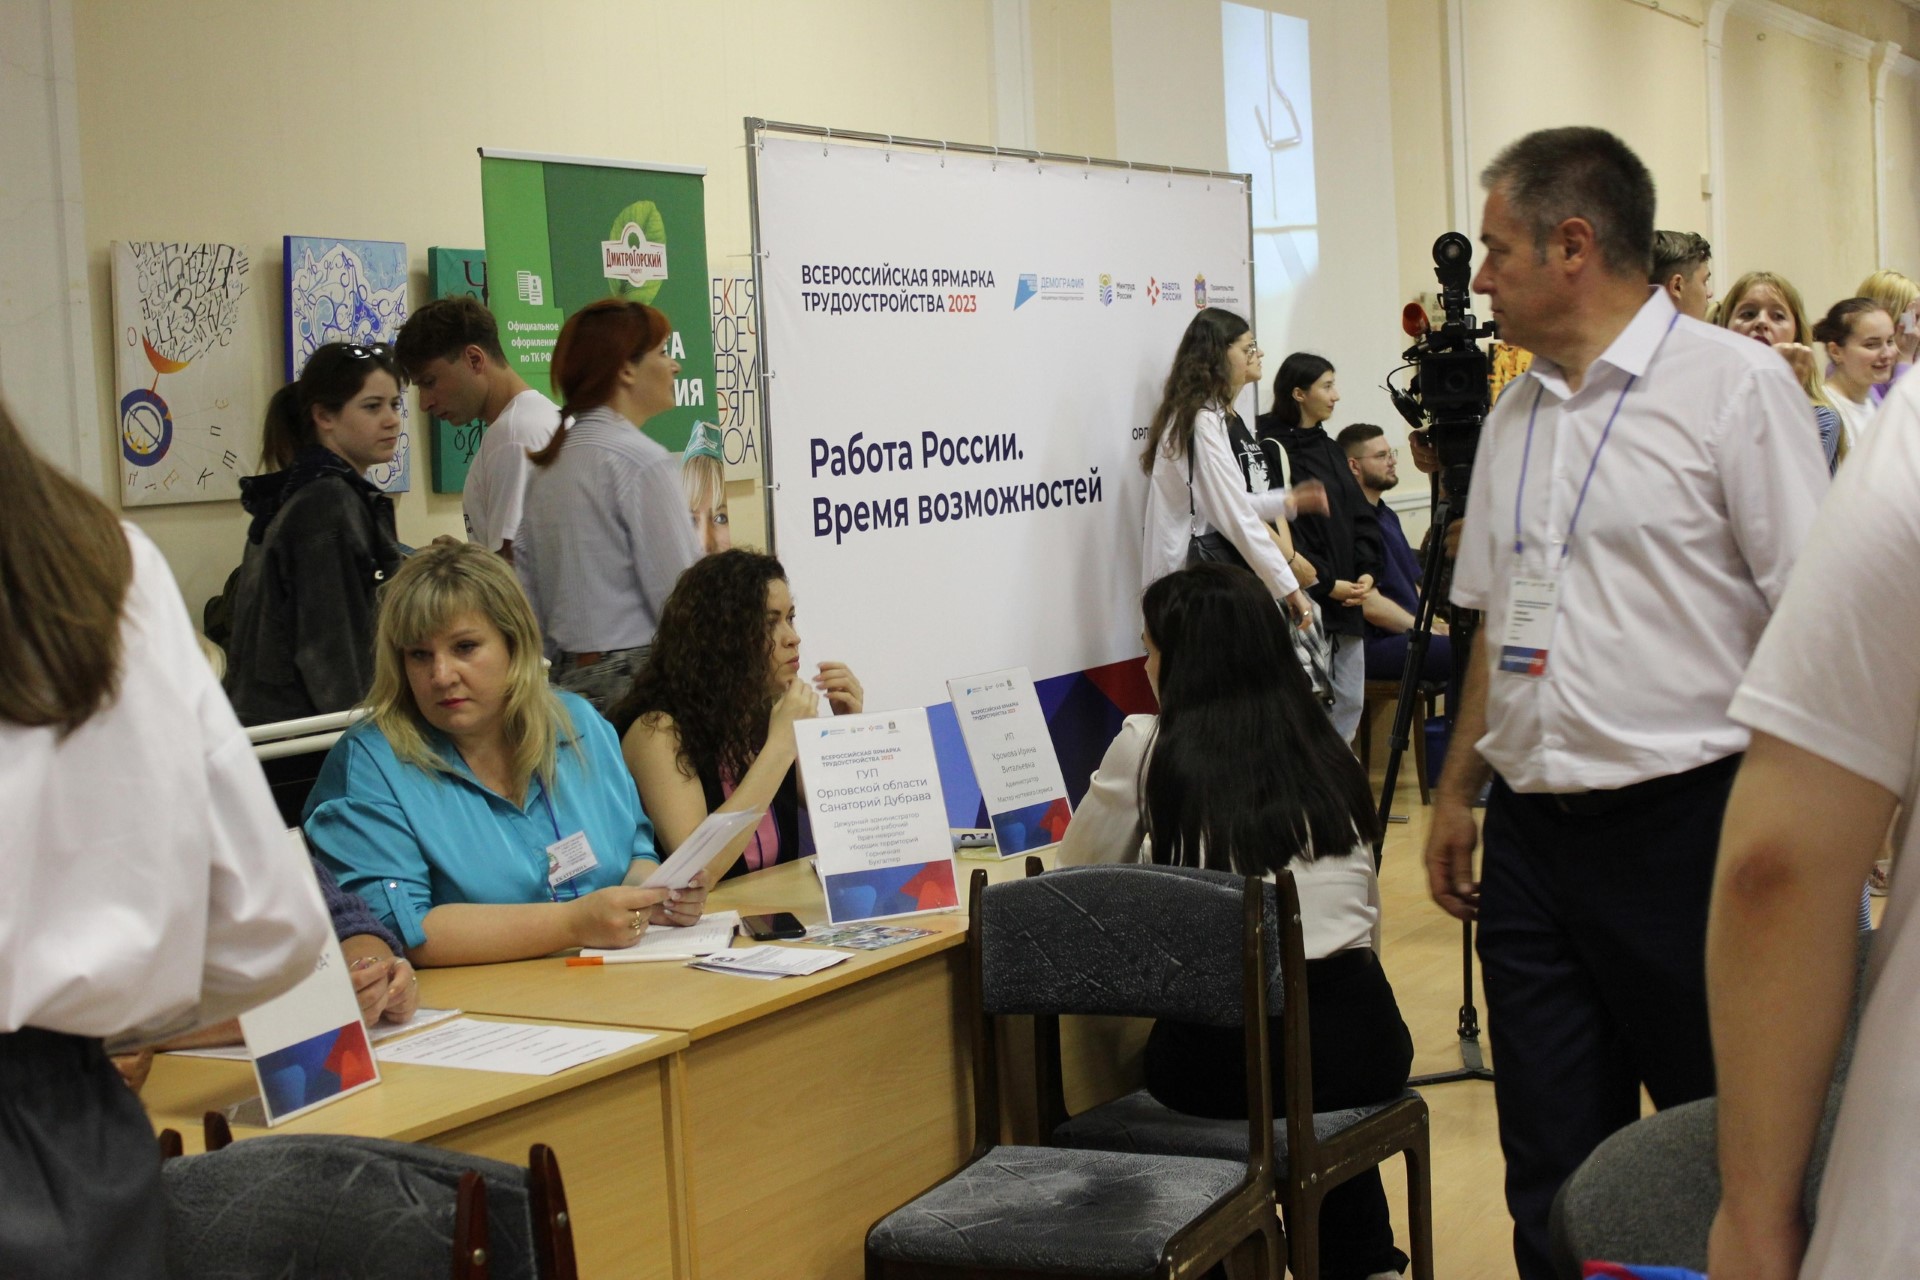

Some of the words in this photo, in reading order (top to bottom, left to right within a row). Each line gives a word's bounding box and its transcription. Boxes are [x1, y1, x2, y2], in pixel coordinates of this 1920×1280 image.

[801, 262, 928, 287] ВСЕРОССИЙСКАЯ
[932, 268, 996, 289] ЯРМАРКА
[1040, 276, 1085, 291] ДЕМОГРАФИЯ
[801, 289, 945, 316] ТРУДОУСТРОЙСТВА
[948, 294, 977, 313] 2023
[507, 320, 559, 333] Официальное
[511, 336, 557, 349] оформление
[520, 354, 530, 362] по
[530, 352, 540, 362] ТК
[540, 352, 552, 362] РФ
[810, 431, 913, 478] Работа
[922, 430, 1023, 468] России.
[813, 496, 909, 545] Время
[918, 466, 1102, 524] возможностей
[1004, 732, 1015, 742] ИП
[821, 749, 873, 761] ВСЕРОССИЙСКАЯ
[873, 747, 902, 756] ЯРМАРКА
[822, 756, 880, 768] ТРУДОУСТРОЙСТВА
[881, 754, 895, 762] 2023
[856, 768, 879, 780] ГУП
[816, 783, 880, 799] Орловской
[882, 778, 928, 792] области
[819, 797, 882, 814] Санаторий
[883, 791, 932, 807] Дубрава
